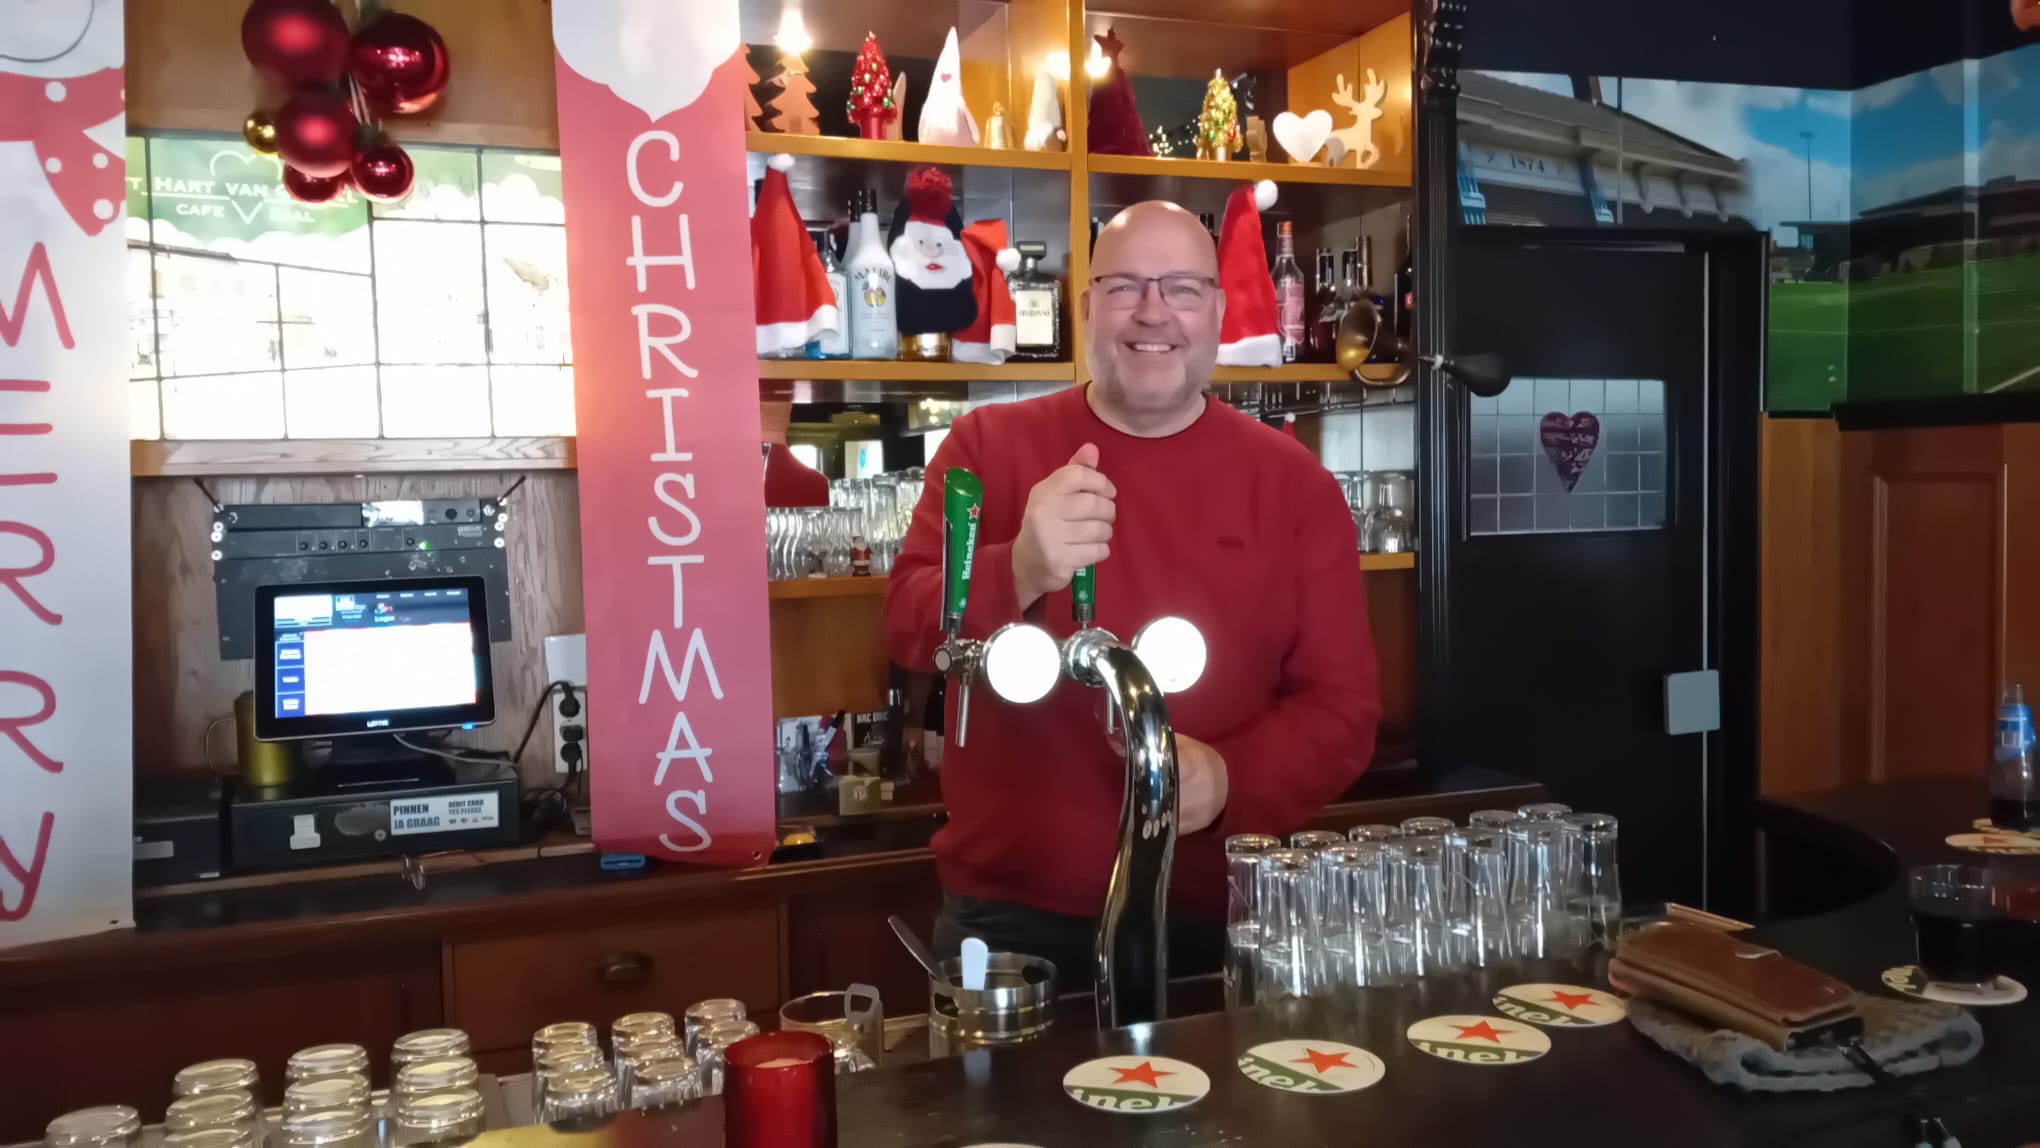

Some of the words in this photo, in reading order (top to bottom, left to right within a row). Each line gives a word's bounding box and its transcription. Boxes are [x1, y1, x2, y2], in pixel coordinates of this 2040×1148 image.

[154, 175, 215, 196] HART
[225, 182, 268, 198] VAN
[626, 129, 724, 853] CHRISTMAS
[962, 521, 977, 580] Heineken
[393, 803, 429, 816] PINNEN
[406, 816, 441, 829] GRAAG
